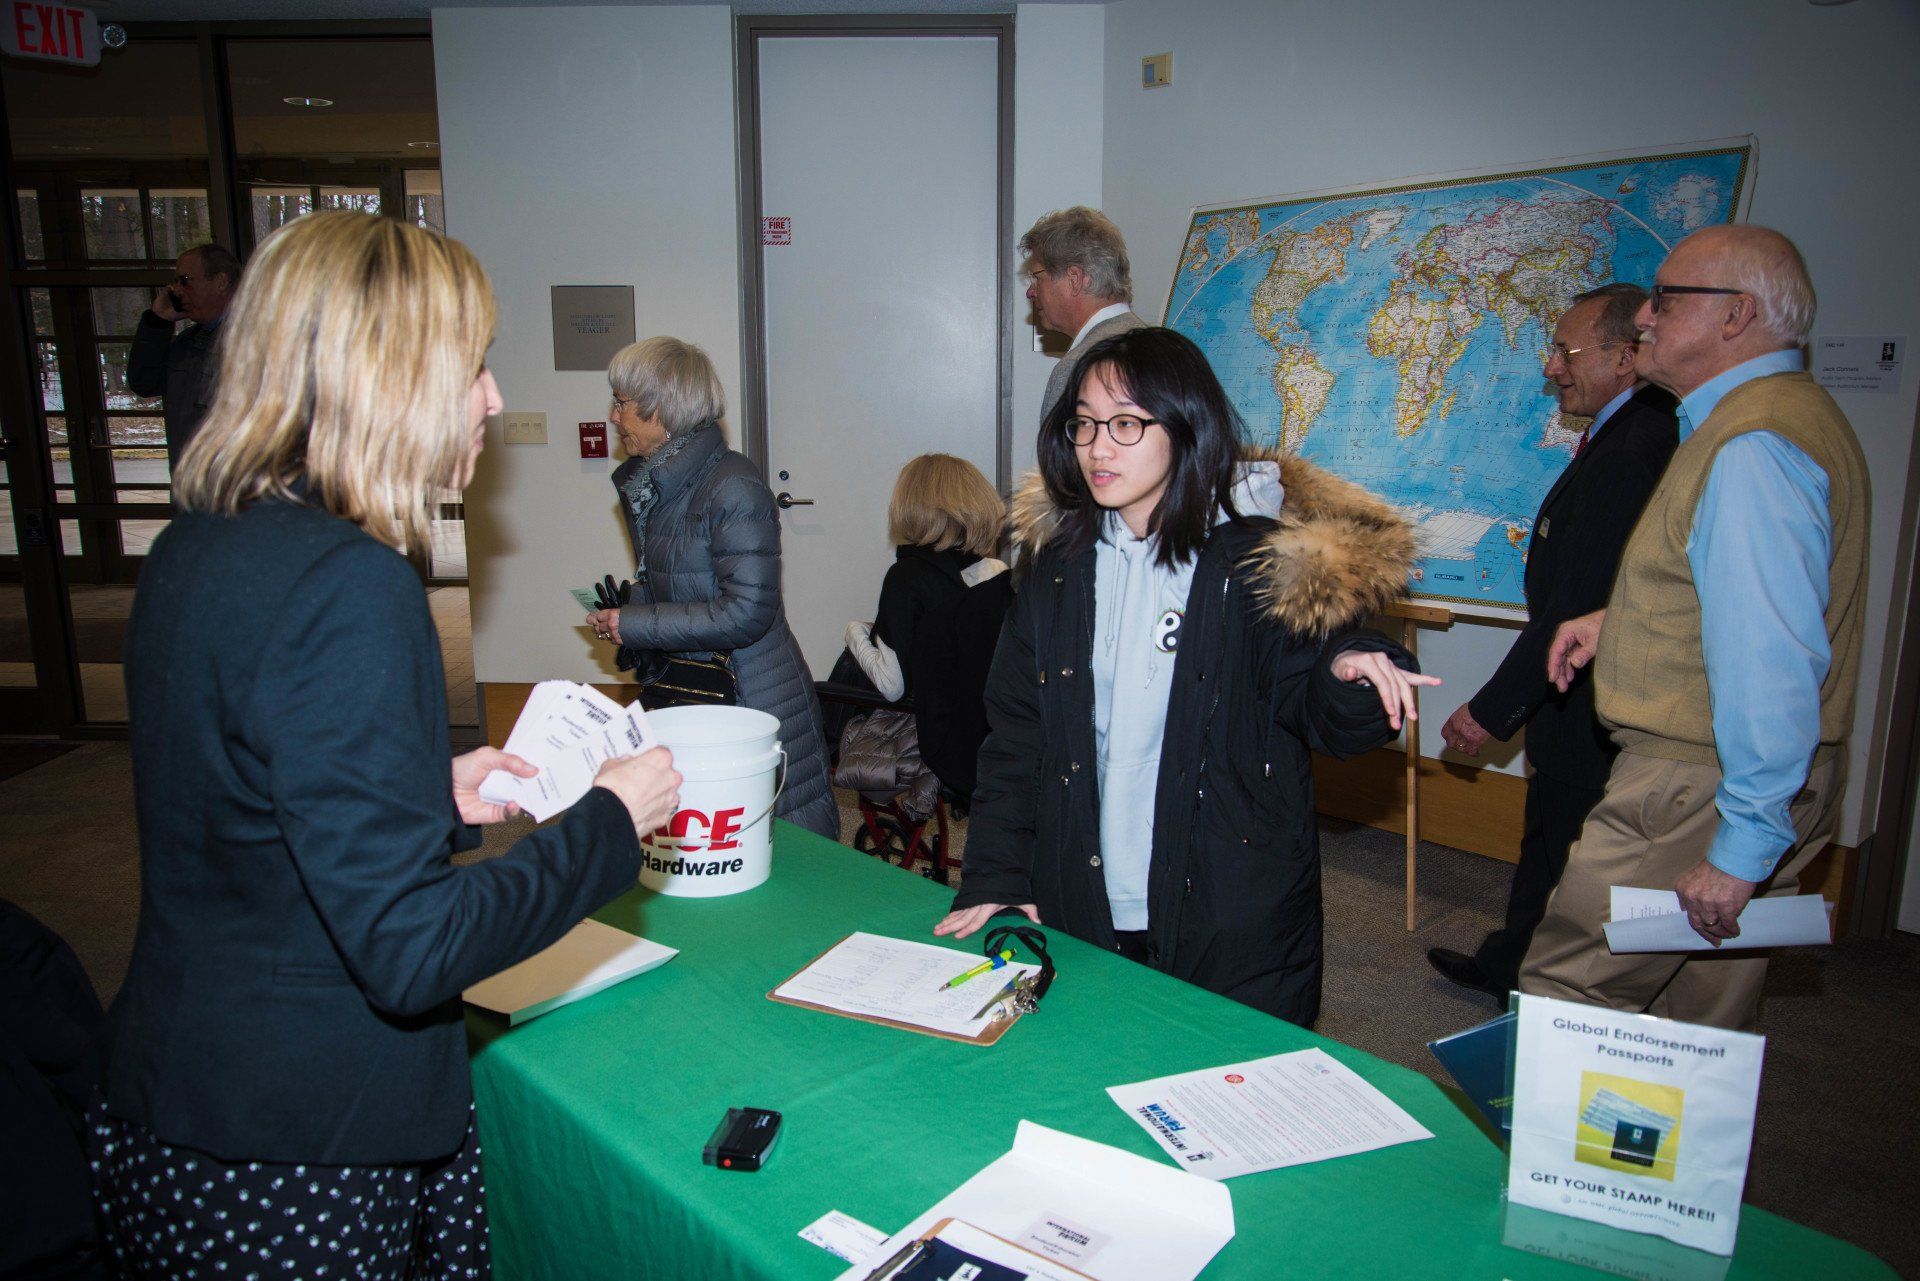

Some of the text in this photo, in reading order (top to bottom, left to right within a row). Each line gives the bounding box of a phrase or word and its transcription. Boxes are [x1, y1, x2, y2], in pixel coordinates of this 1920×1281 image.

[14, 2, 85, 59] EXIT
[768, 221, 786, 229] FIRE
[641, 849, 743, 875] Hardware
[1553, 1018, 1726, 1058] Global Endorsement
[1597, 1044, 1674, 1067] Passports
[1137, 1106, 1188, 1151] INTERNATIONAL
[1147, 1103, 1186, 1131] FORUM
[1530, 1172, 1715, 1222] GET YOUR STAMP HERE!!
